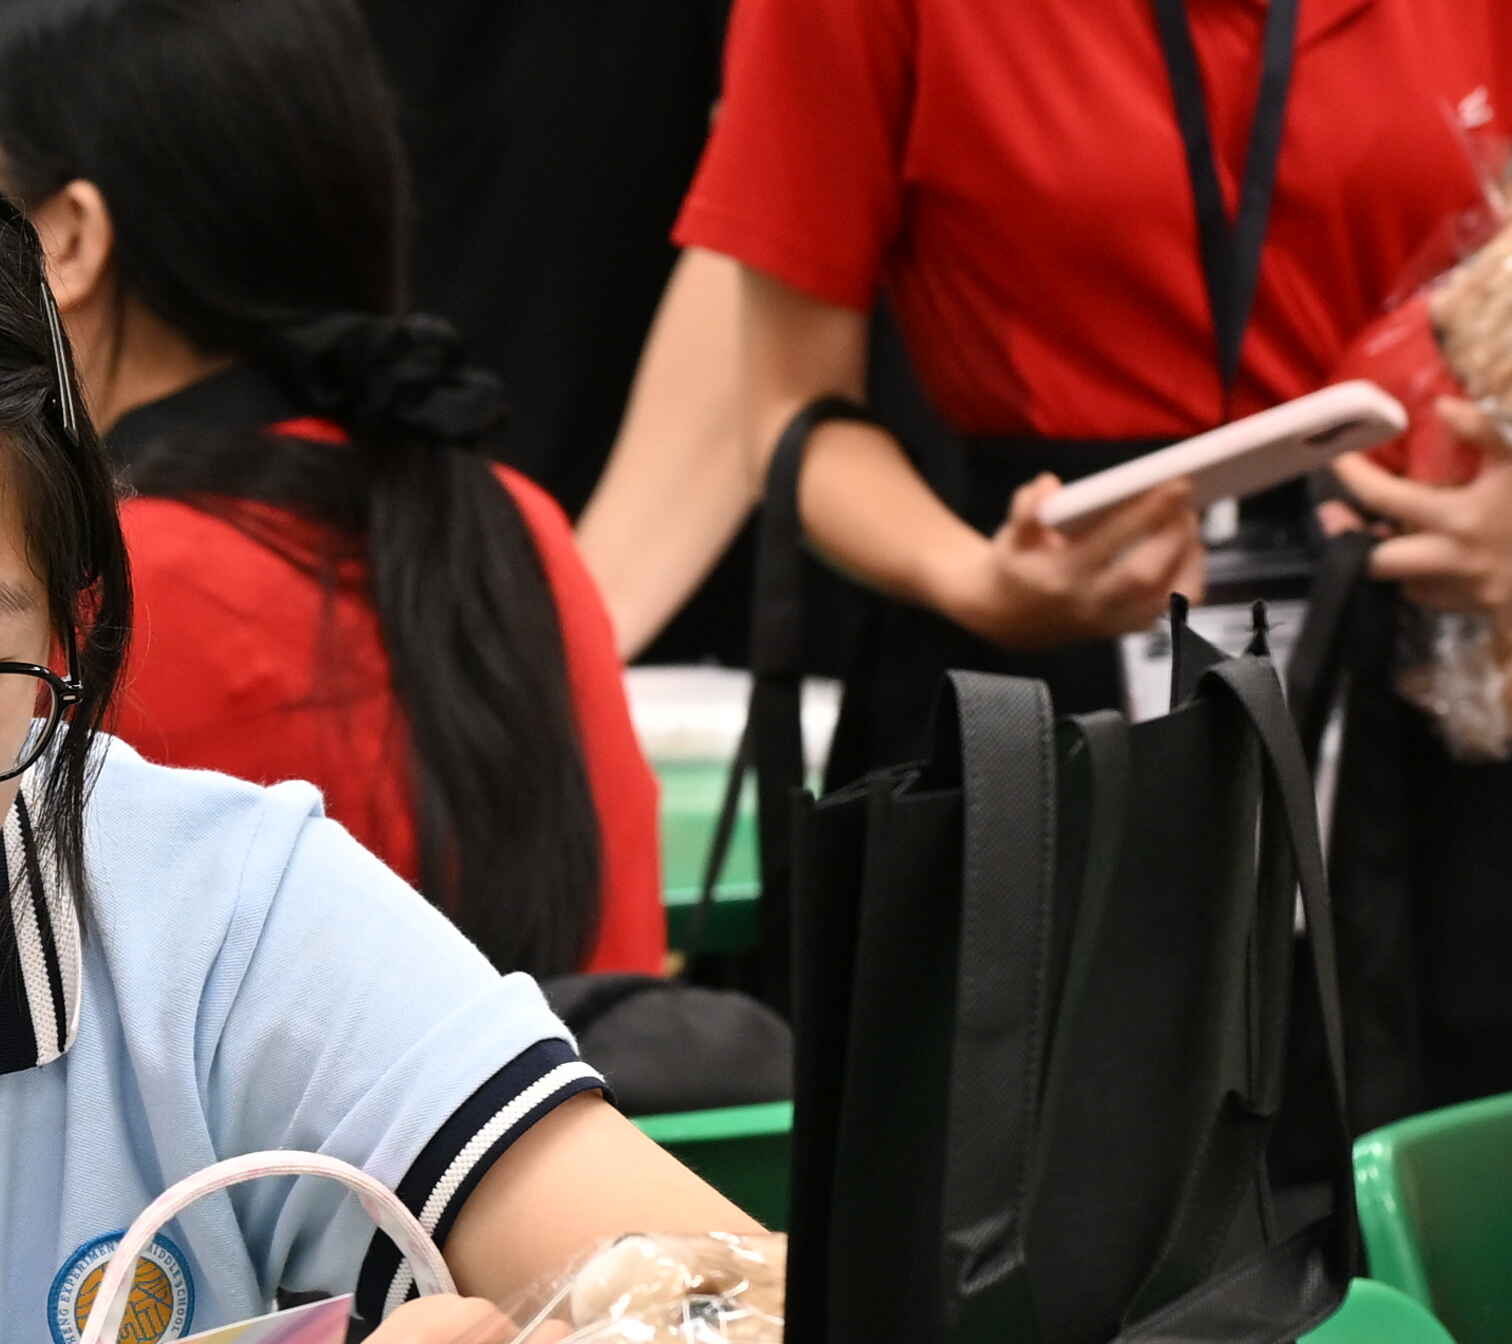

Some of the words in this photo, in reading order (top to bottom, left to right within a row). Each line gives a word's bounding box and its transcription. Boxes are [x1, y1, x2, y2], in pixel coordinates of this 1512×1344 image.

[60, 1241, 116, 1303] EXPERIMEN
[149, 1243, 181, 1277] IDDLE
[171, 1280, 188, 1333] SCHOOL
